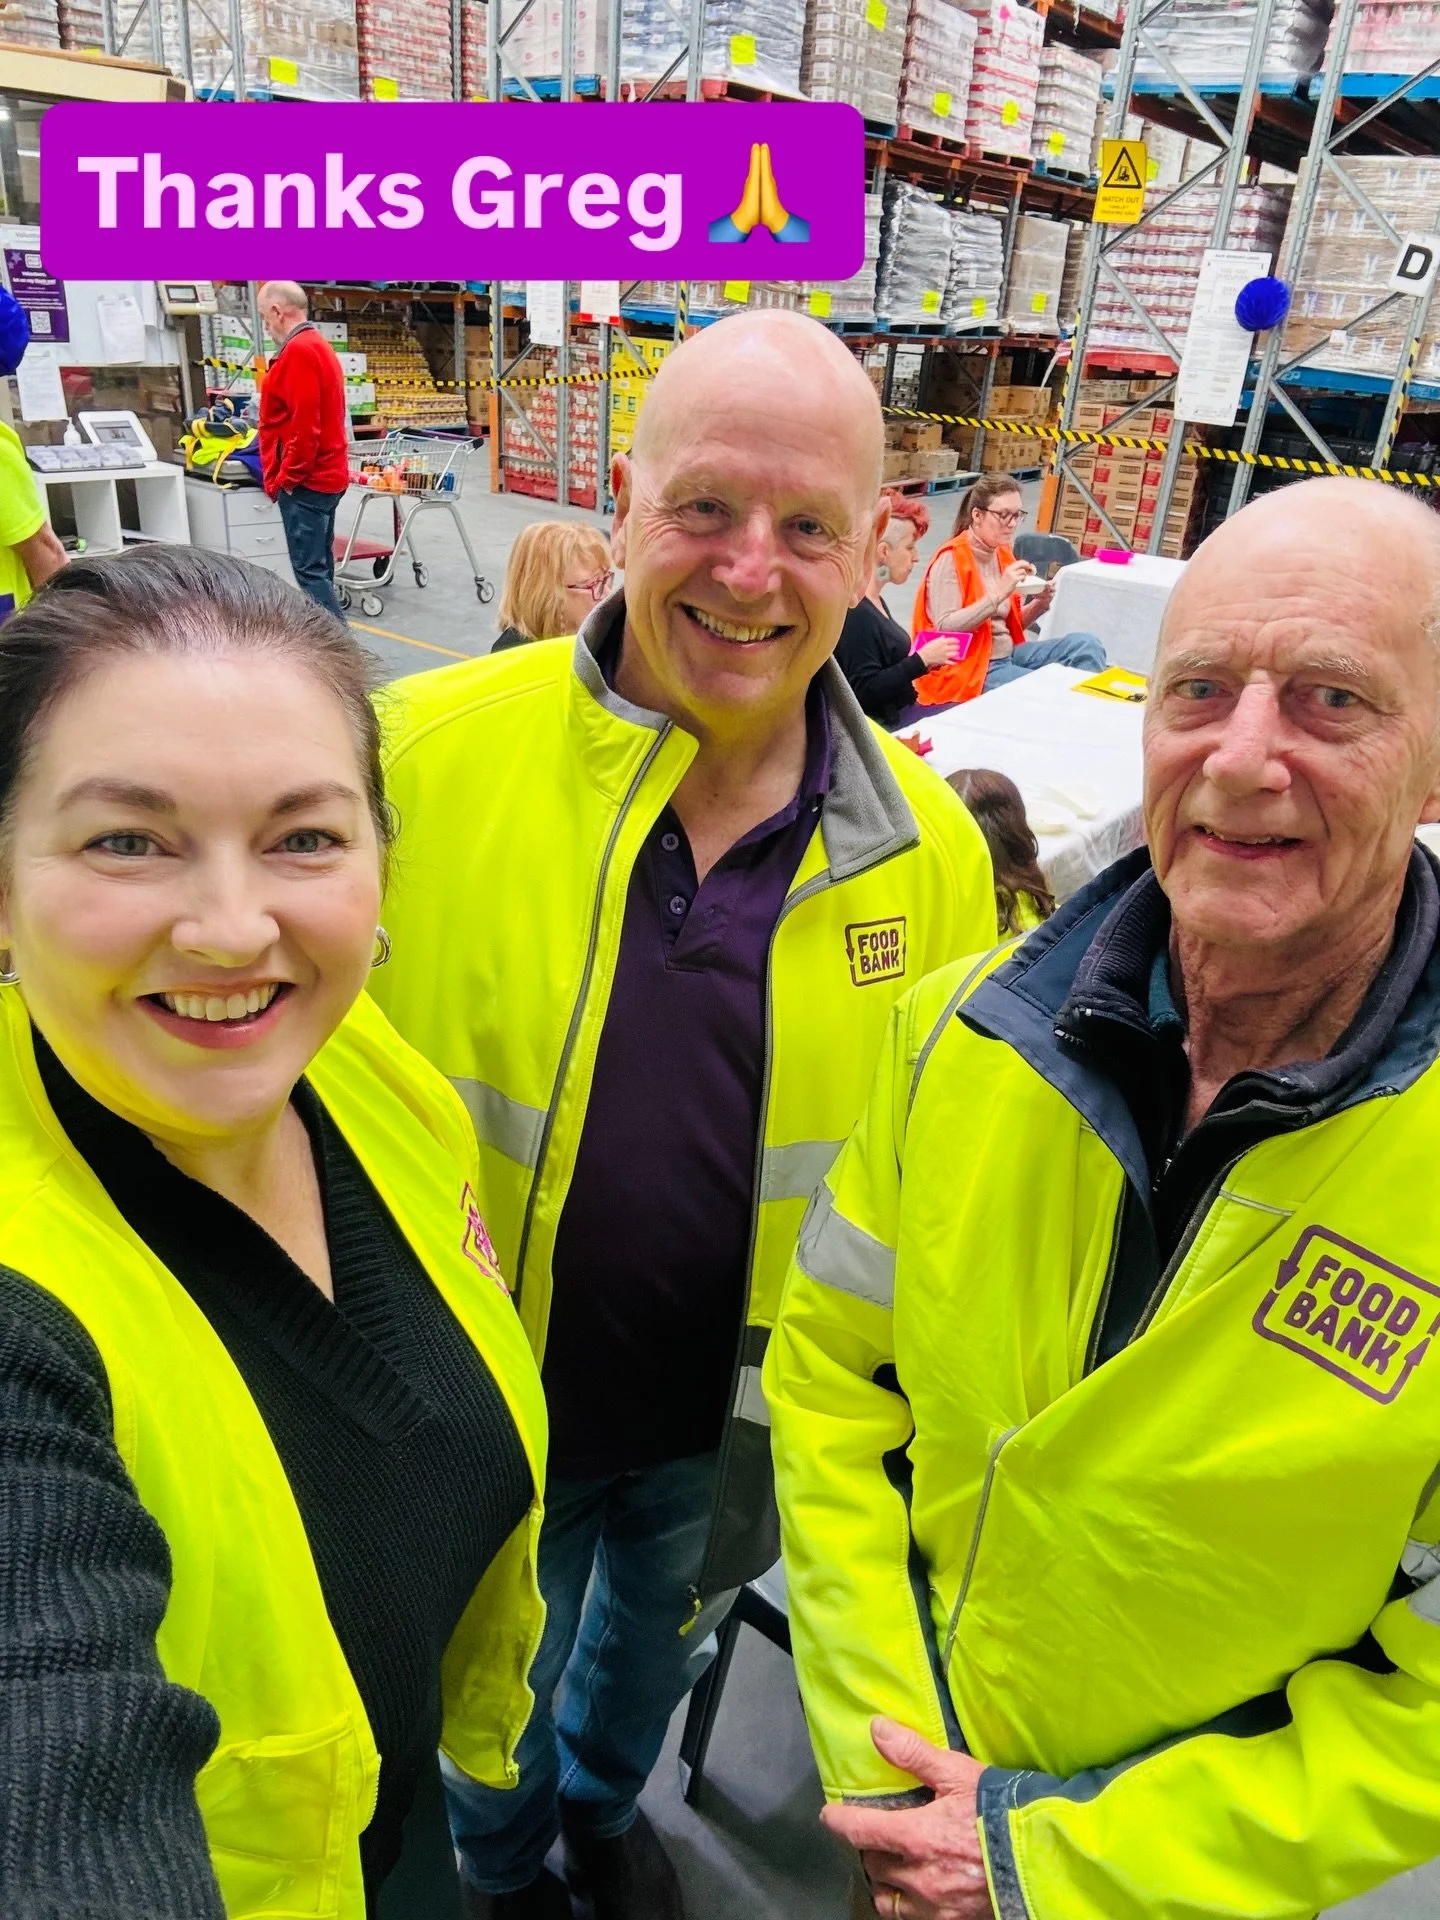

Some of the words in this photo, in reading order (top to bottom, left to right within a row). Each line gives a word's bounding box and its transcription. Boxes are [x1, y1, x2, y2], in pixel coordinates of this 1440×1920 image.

[1397, 244, 1432, 280] D
[858, 929, 899, 954] FOOD
[860, 948, 900, 975] BANK
[1305, 1254, 1421, 1337] FOOD
[1284, 1291, 1401, 1375] BANK
